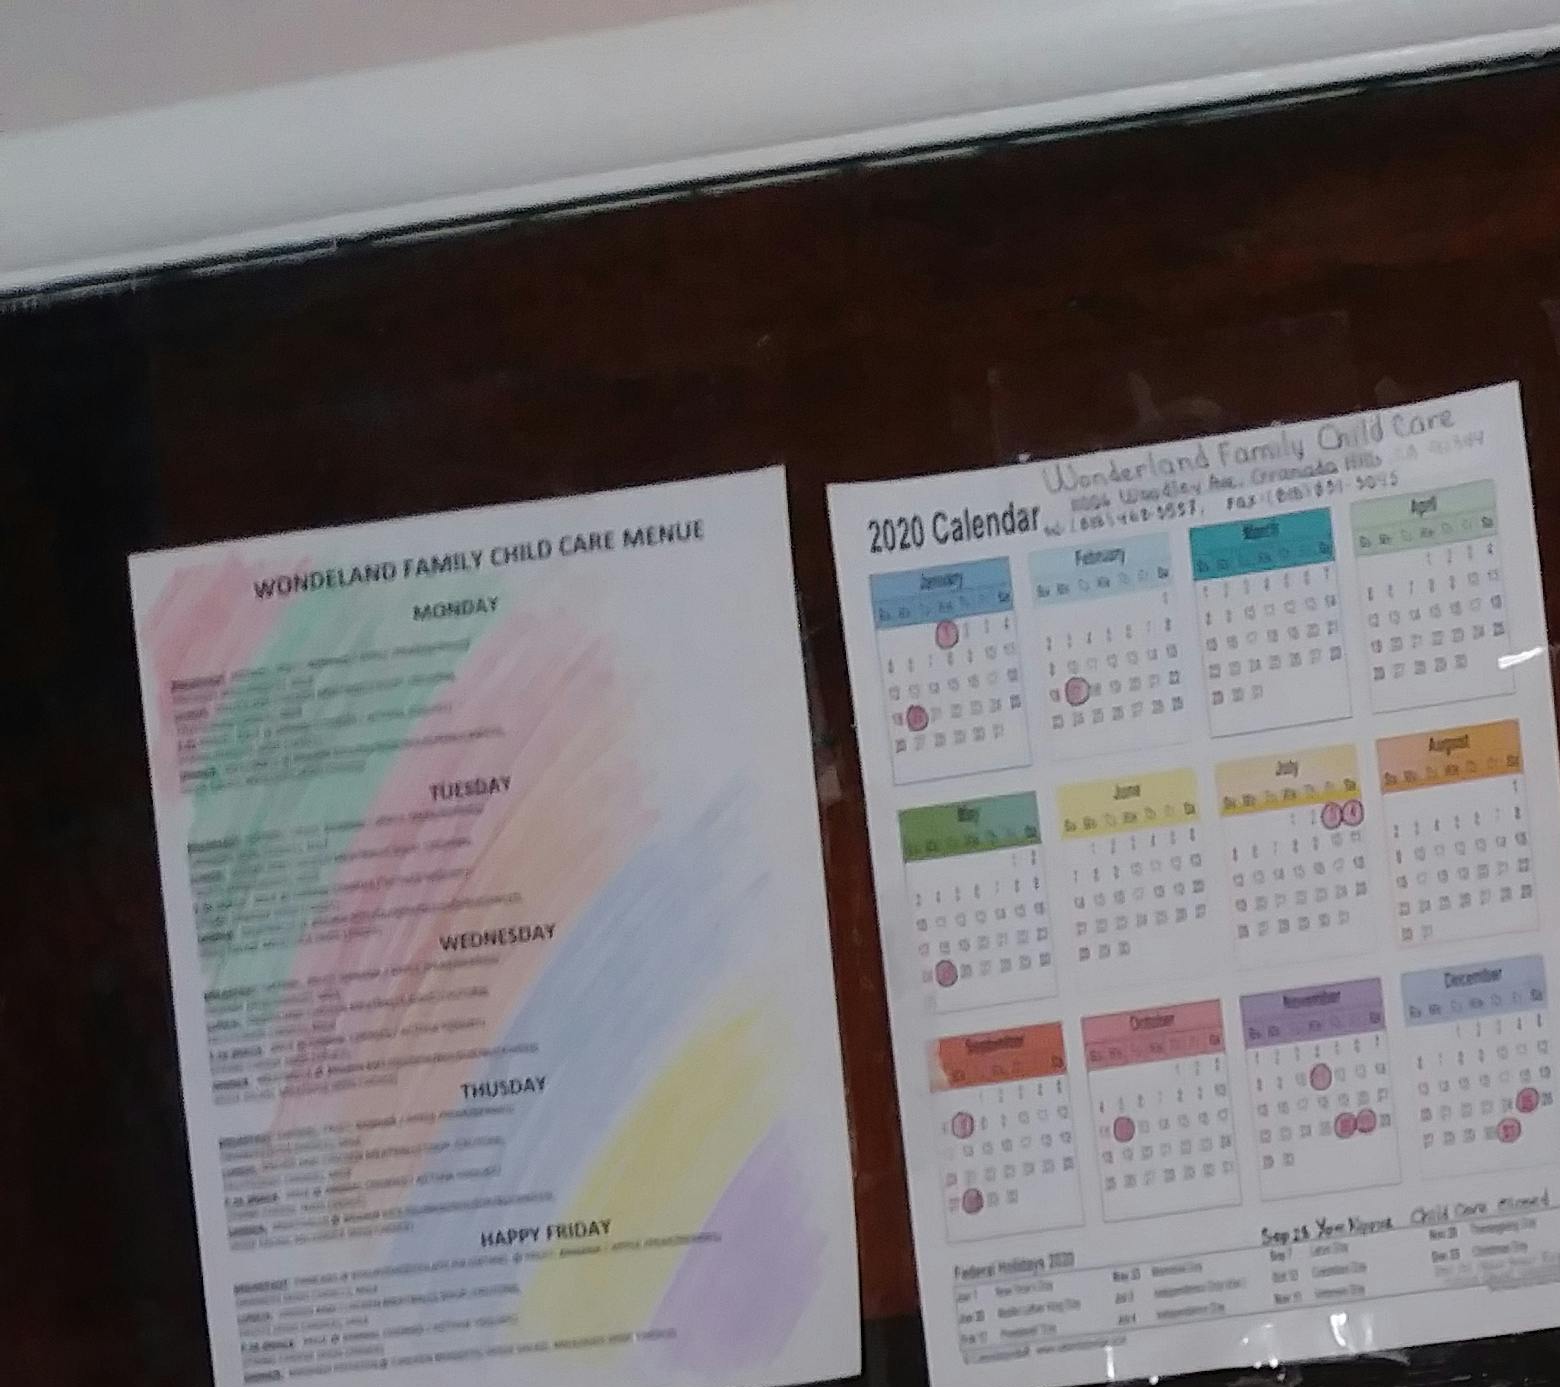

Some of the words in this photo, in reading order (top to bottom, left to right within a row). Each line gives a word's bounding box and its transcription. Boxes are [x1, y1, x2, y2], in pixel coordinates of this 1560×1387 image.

[1042, 441, 1209, 493] Wonderland
[1217, 430, 1304, 467] Family
[1318, 413, 1385, 450] Child
[1392, 409, 1456, 438] Care
[868, 513, 925, 553] 2020
[932, 500, 1041, 545] Calendar
[253, 562, 399, 601] WONDELAND
[402, 551, 483, 581] FAMILY
[490, 540, 552, 567] CHILD
[559, 529, 614, 555] CARE
[622, 518, 704, 549] MENUE
[412, 596, 499, 621] MONDAY
[429, 775, 511, 800] TUESDAY
[439, 923, 556, 951] WEDNESDAY
[460, 1076, 546, 1099] THUSDAY
[481, 1226, 539, 1247] HAPPY
[546, 1218, 612, 1240] FRIDAY
